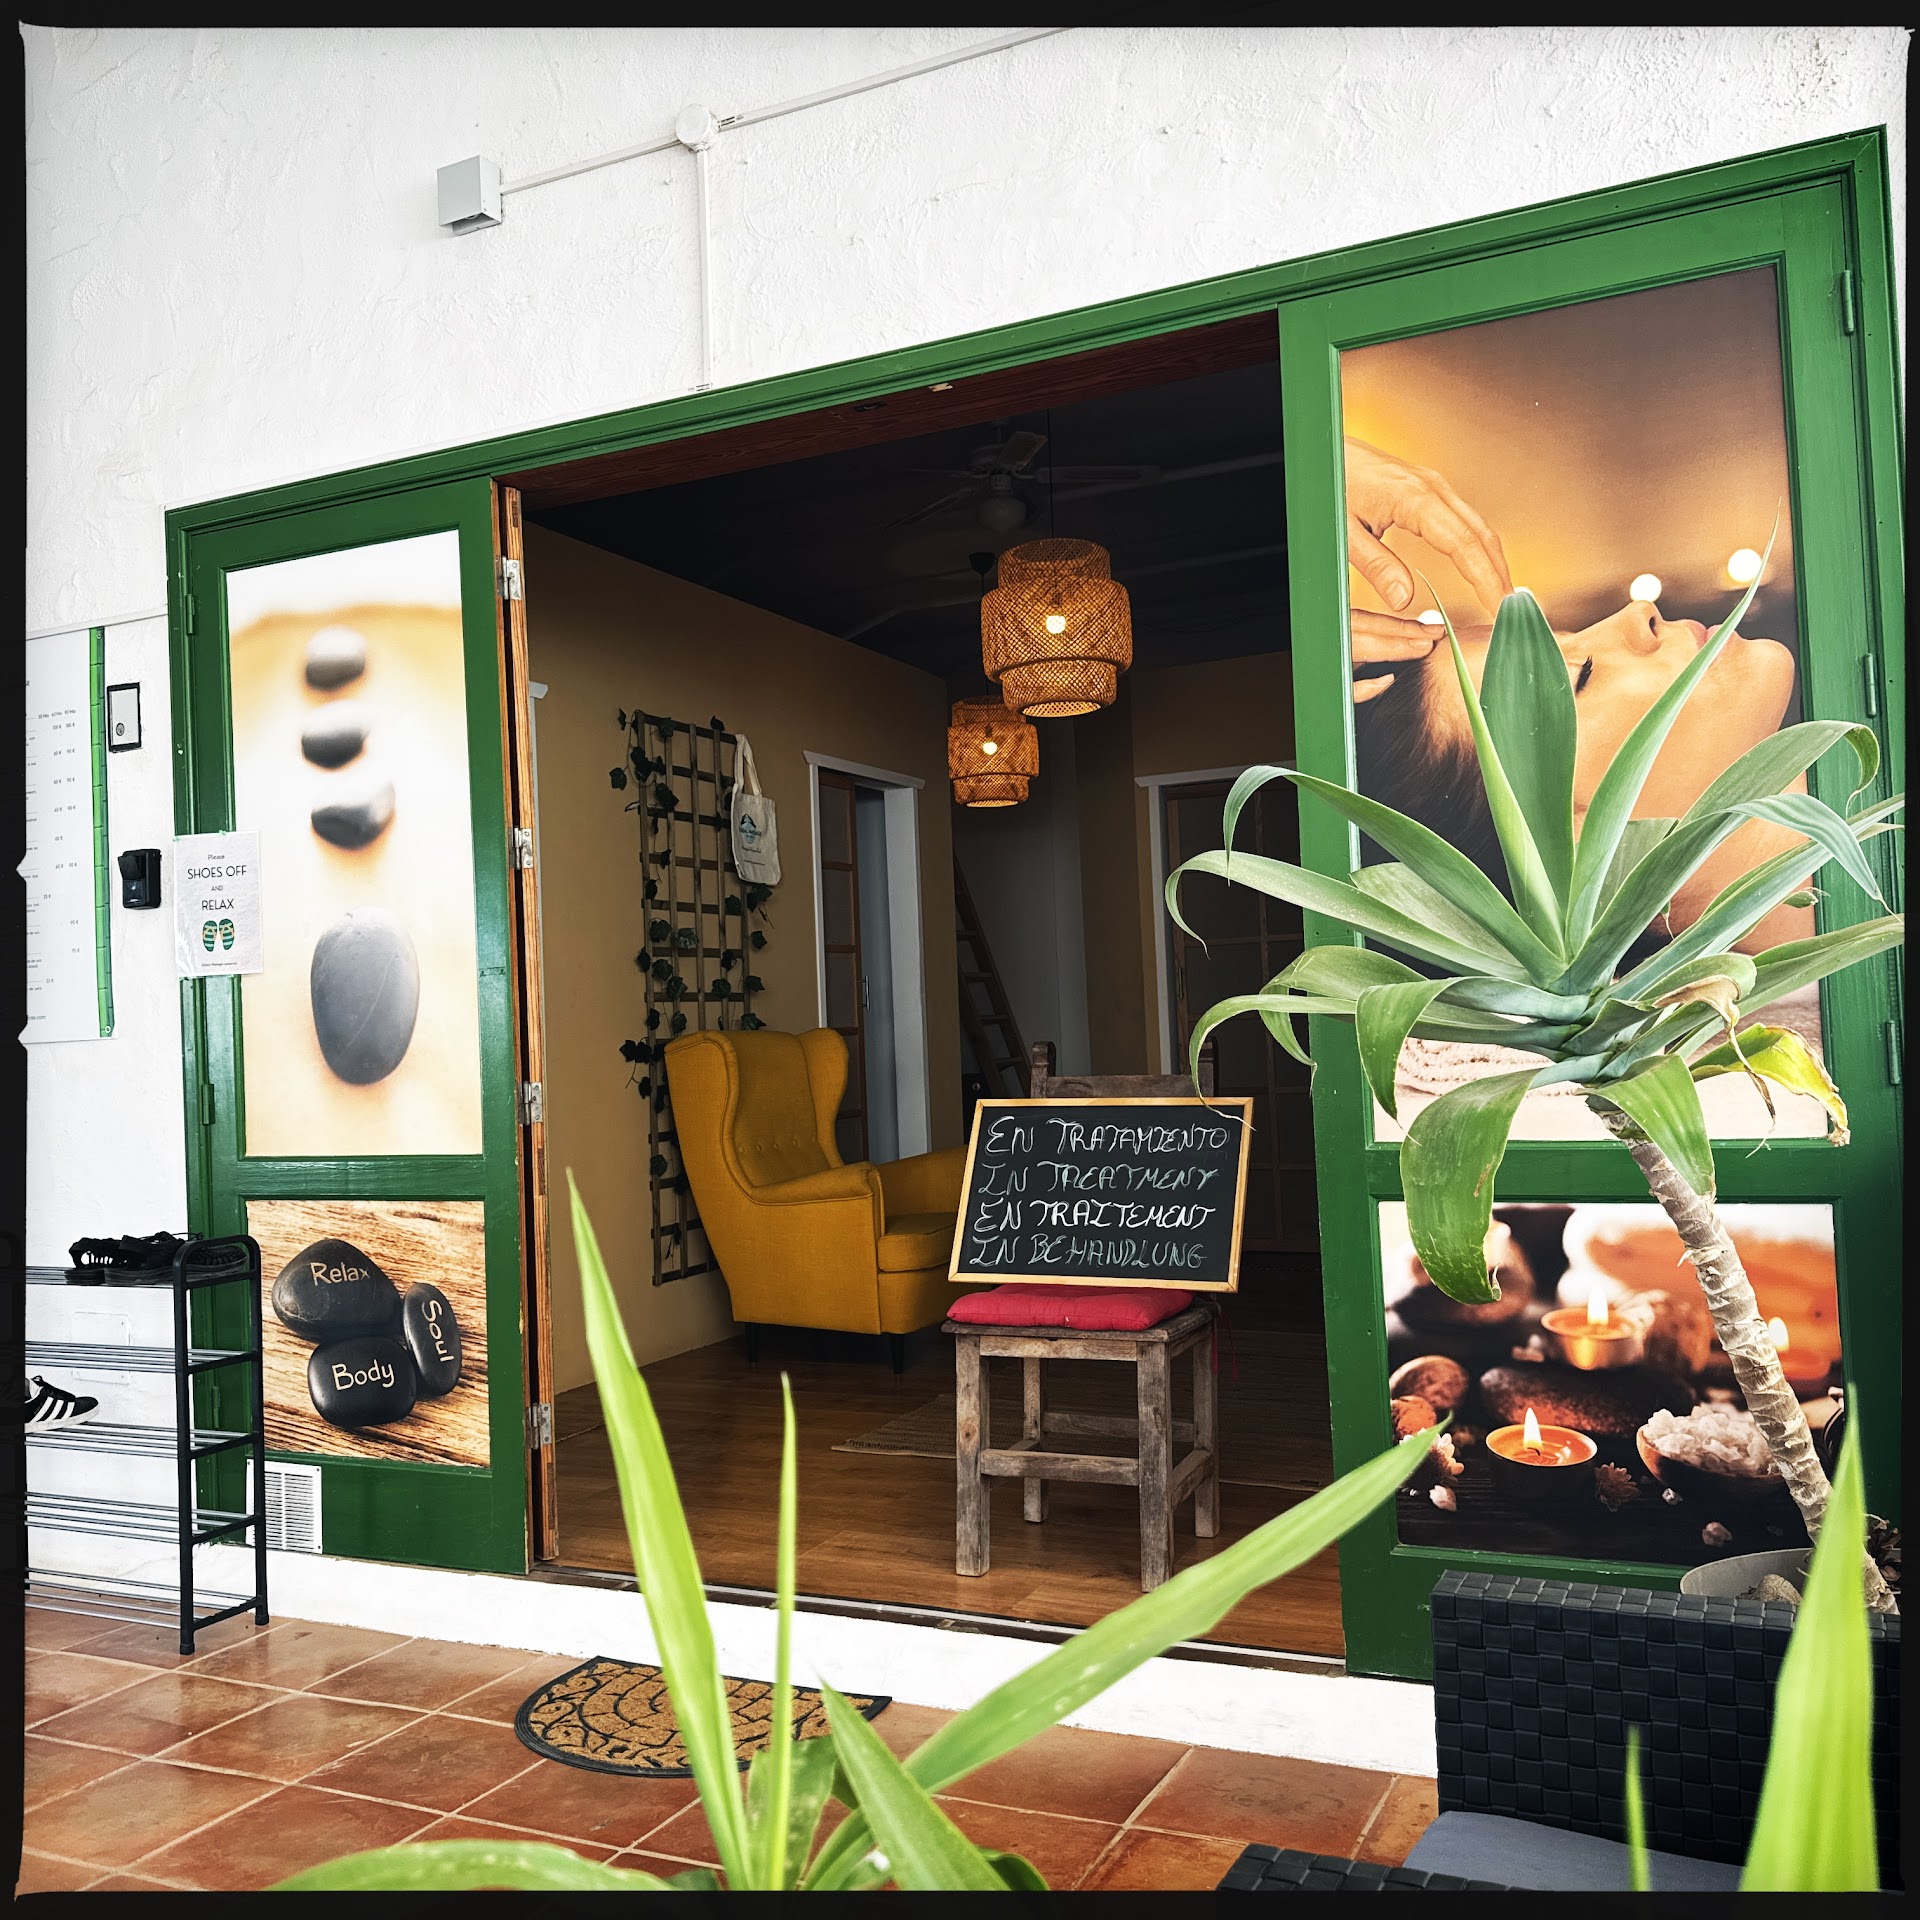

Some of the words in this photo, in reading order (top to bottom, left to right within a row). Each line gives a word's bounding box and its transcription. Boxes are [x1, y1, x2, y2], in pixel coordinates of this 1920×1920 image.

[187, 866, 223, 880] SHOES
[225, 865, 247, 877] OFF
[201, 898, 235, 911] RELAX
[985, 1116, 1035, 1155] EN
[1046, 1117, 1230, 1155] TRATAMIENTO
[978, 1162, 1029, 1196] IN
[973, 1197, 1023, 1232] EN
[1029, 1199, 1217, 1230] TRAITEMENT
[969, 1235, 1021, 1268] IN
[1028, 1232, 1208, 1269] BEHANDLUNG
[310, 1262, 371, 1287] Relax
[421, 1299, 455, 1362] Soul
[331, 1359, 395, 1391] Body
